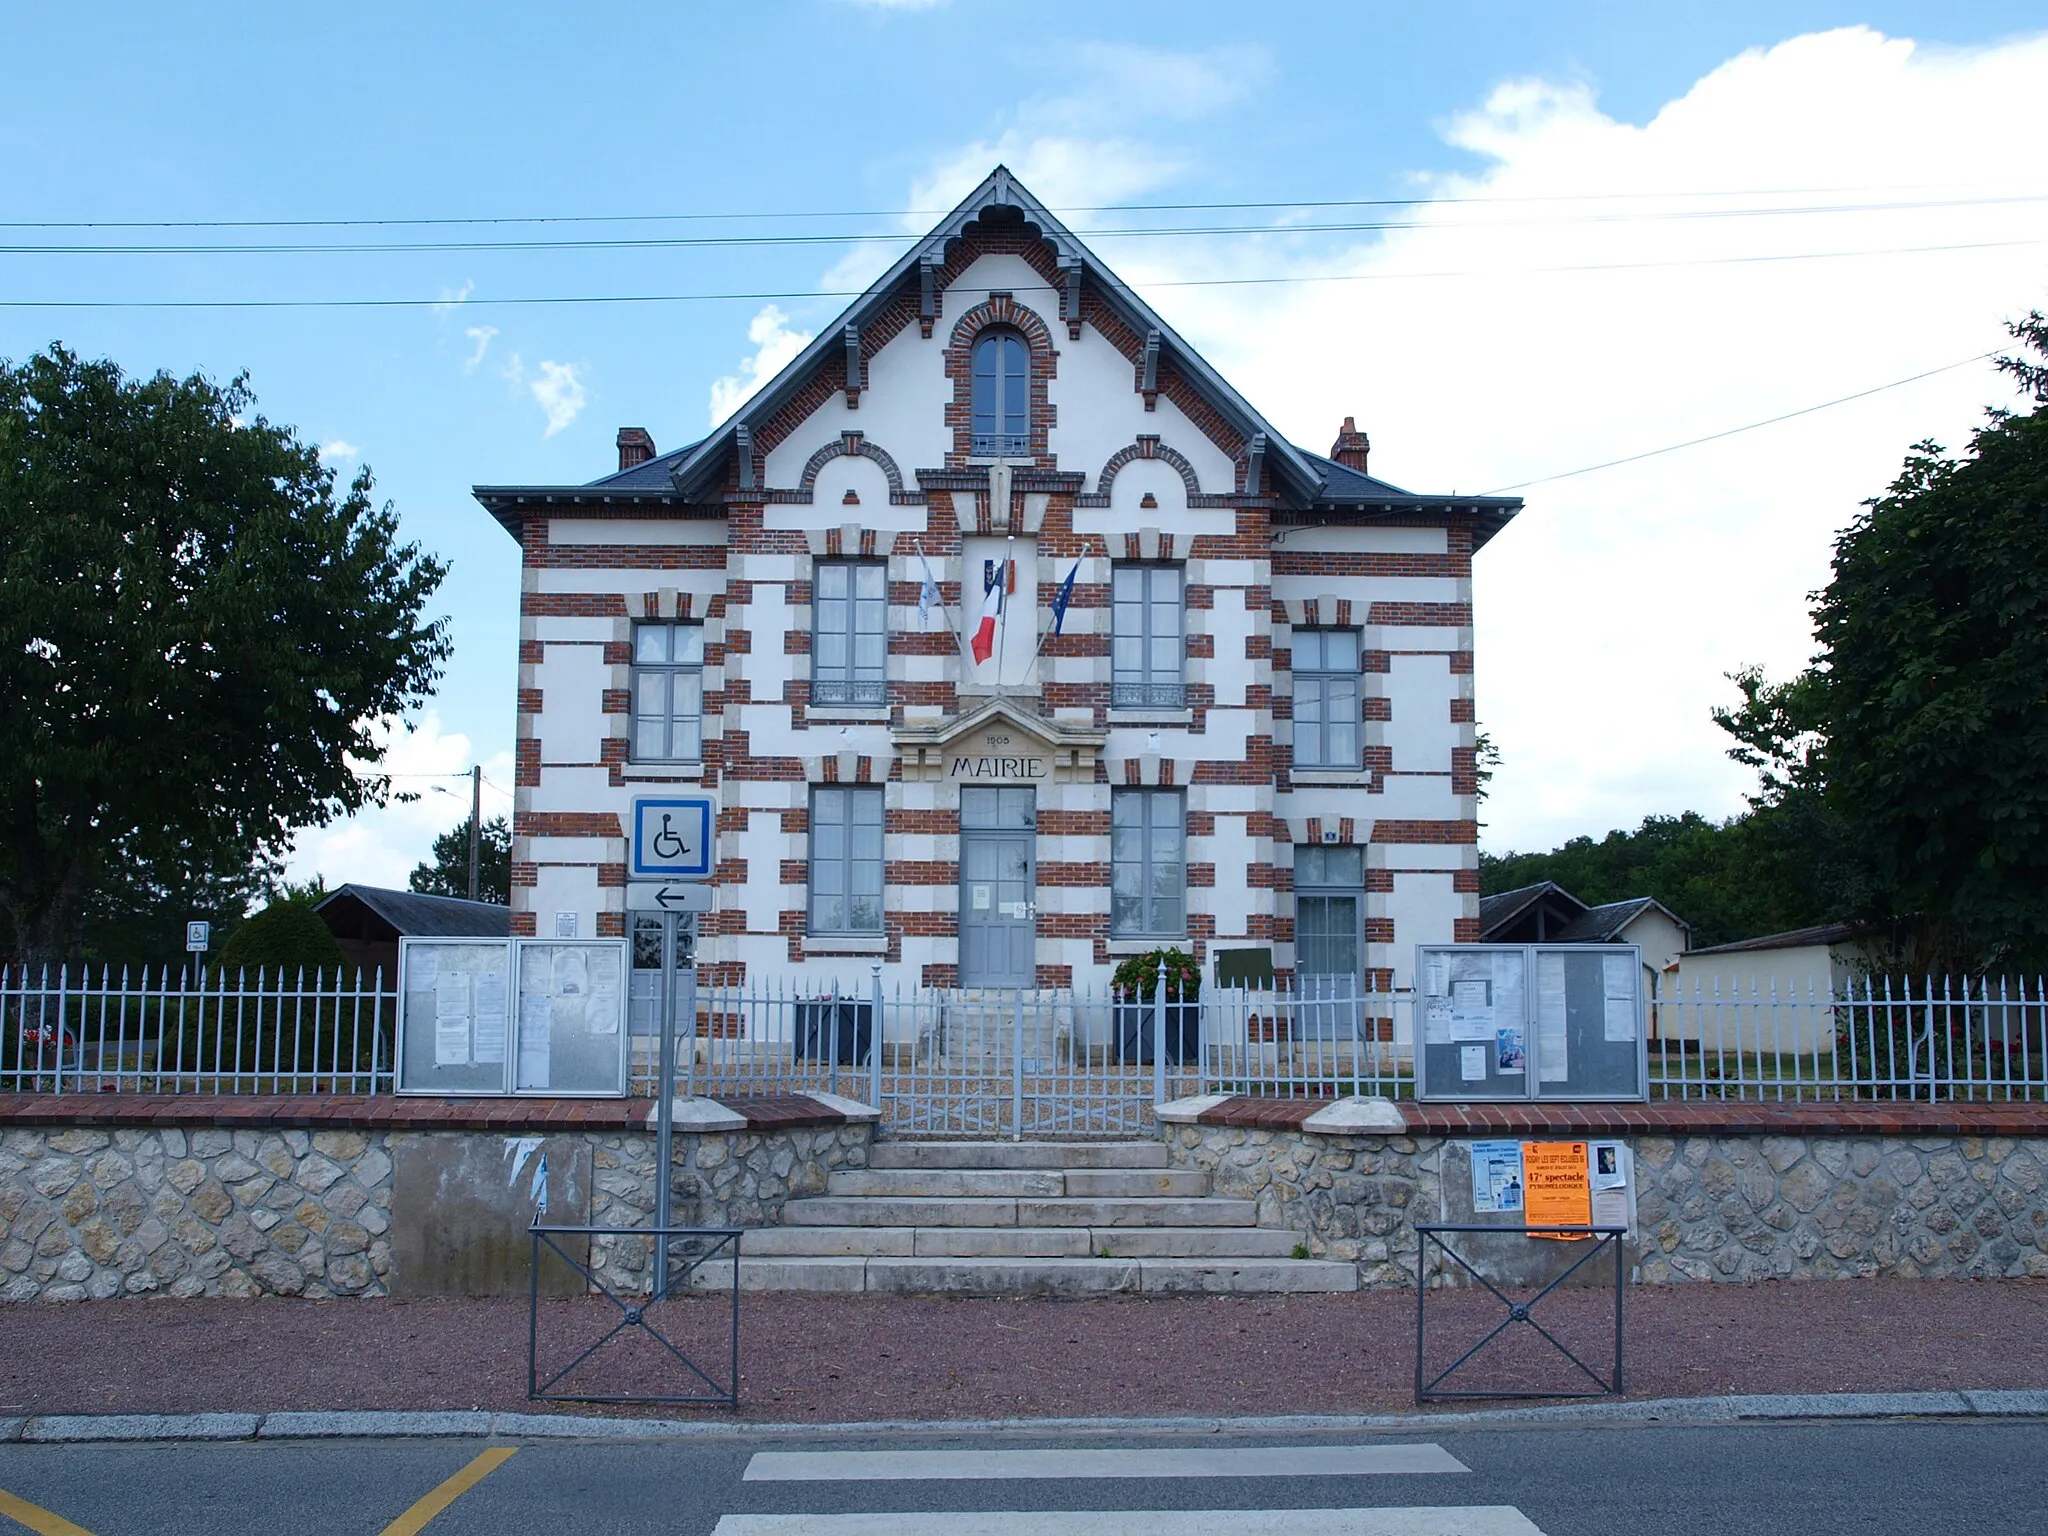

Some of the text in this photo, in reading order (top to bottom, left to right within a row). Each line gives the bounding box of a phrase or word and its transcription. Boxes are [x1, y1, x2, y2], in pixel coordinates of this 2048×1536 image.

[987, 736, 1010, 745] 1905
[950, 757, 1048, 778] MAIRIE
[1545, 1172, 1584, 1183] spectacle
